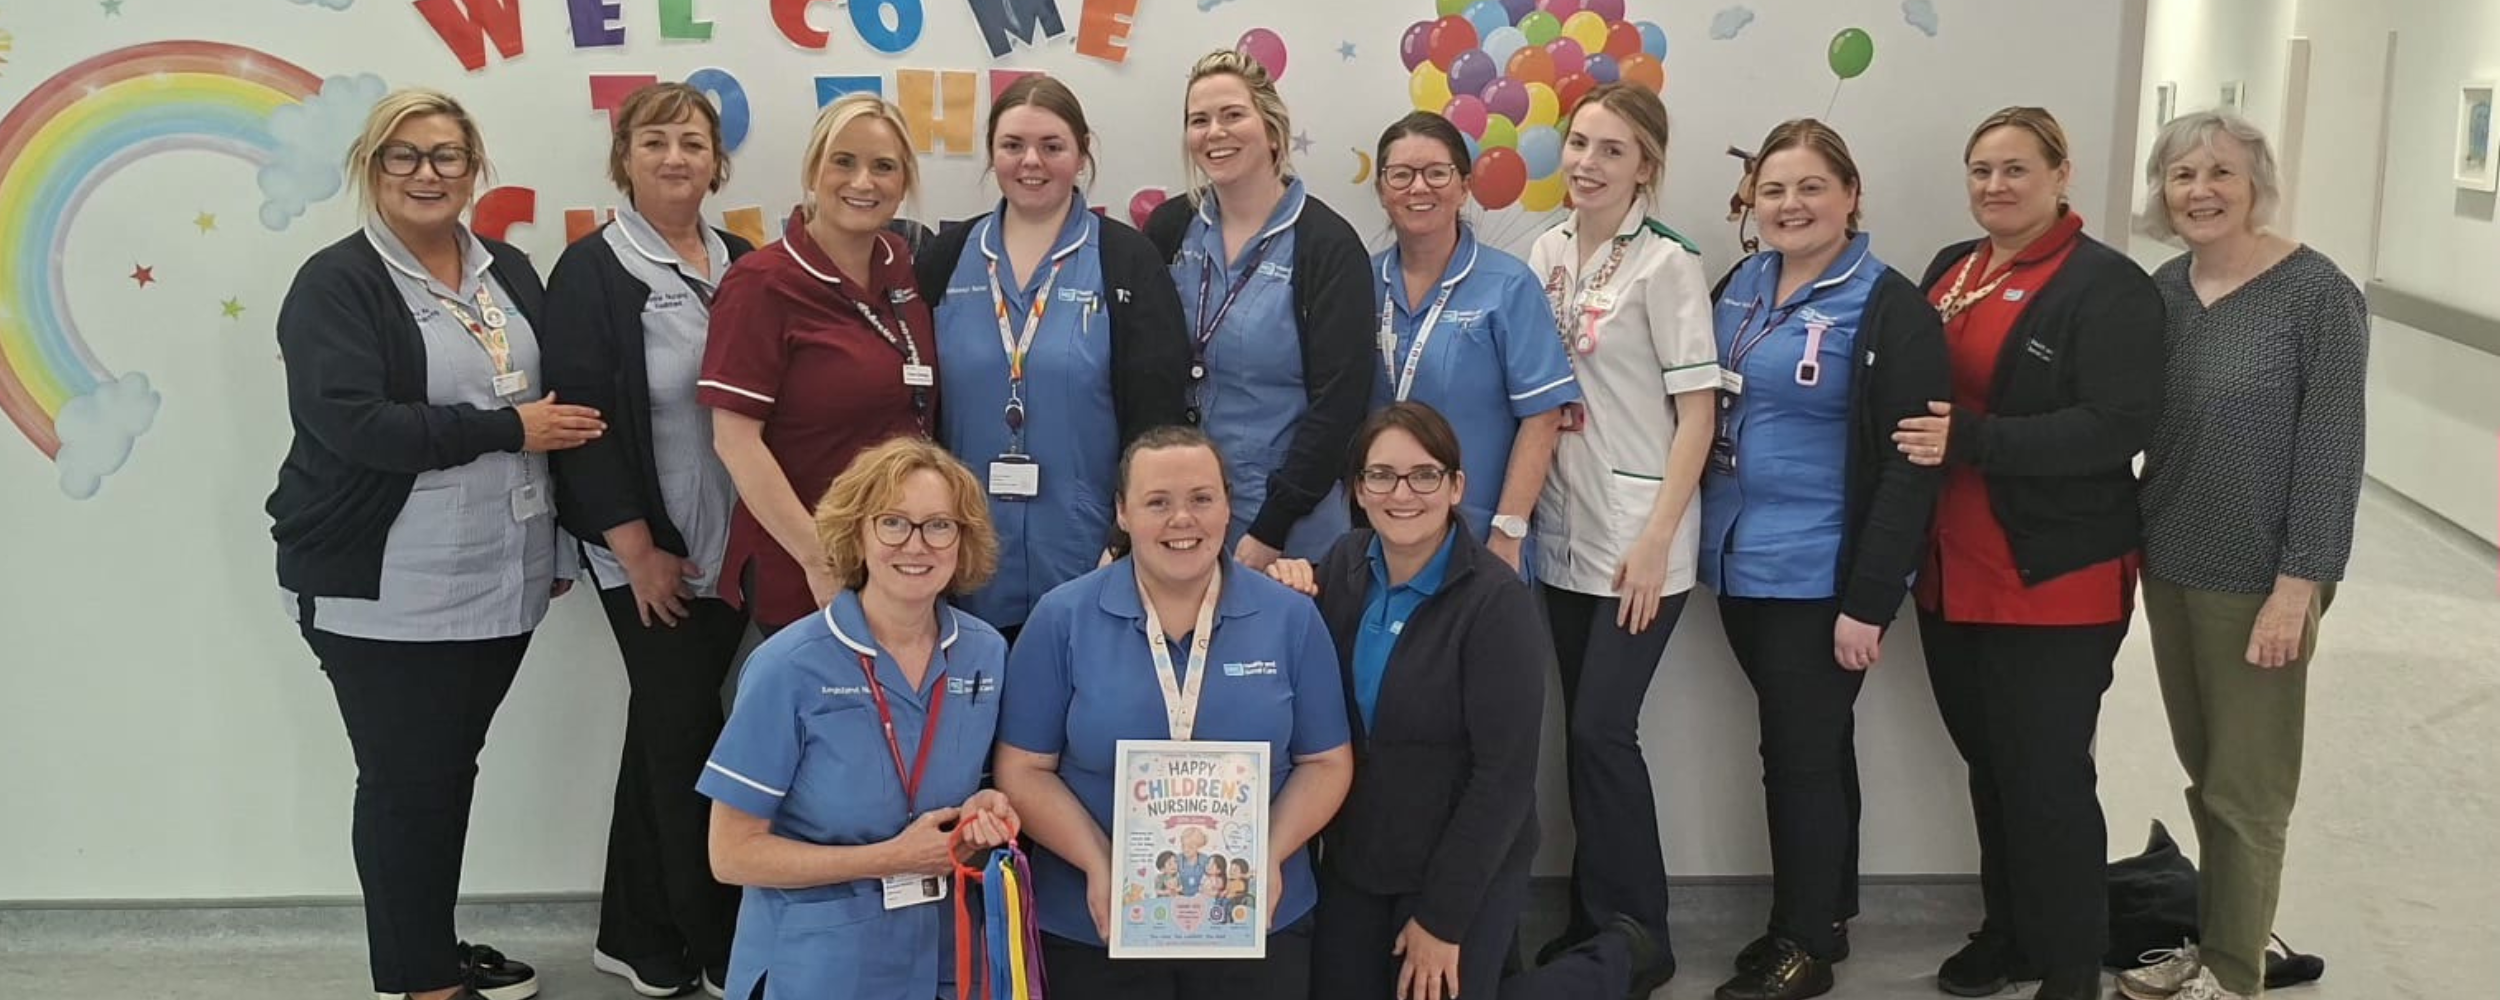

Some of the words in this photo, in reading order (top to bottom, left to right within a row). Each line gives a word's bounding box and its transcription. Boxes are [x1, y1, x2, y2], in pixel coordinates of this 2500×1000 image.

[1168, 760, 1216, 777] HAPPY
[1133, 777, 1250, 804] CHILDREN'S
[1147, 798, 1208, 818] NURSING
[1211, 799, 1238, 818] DAY
